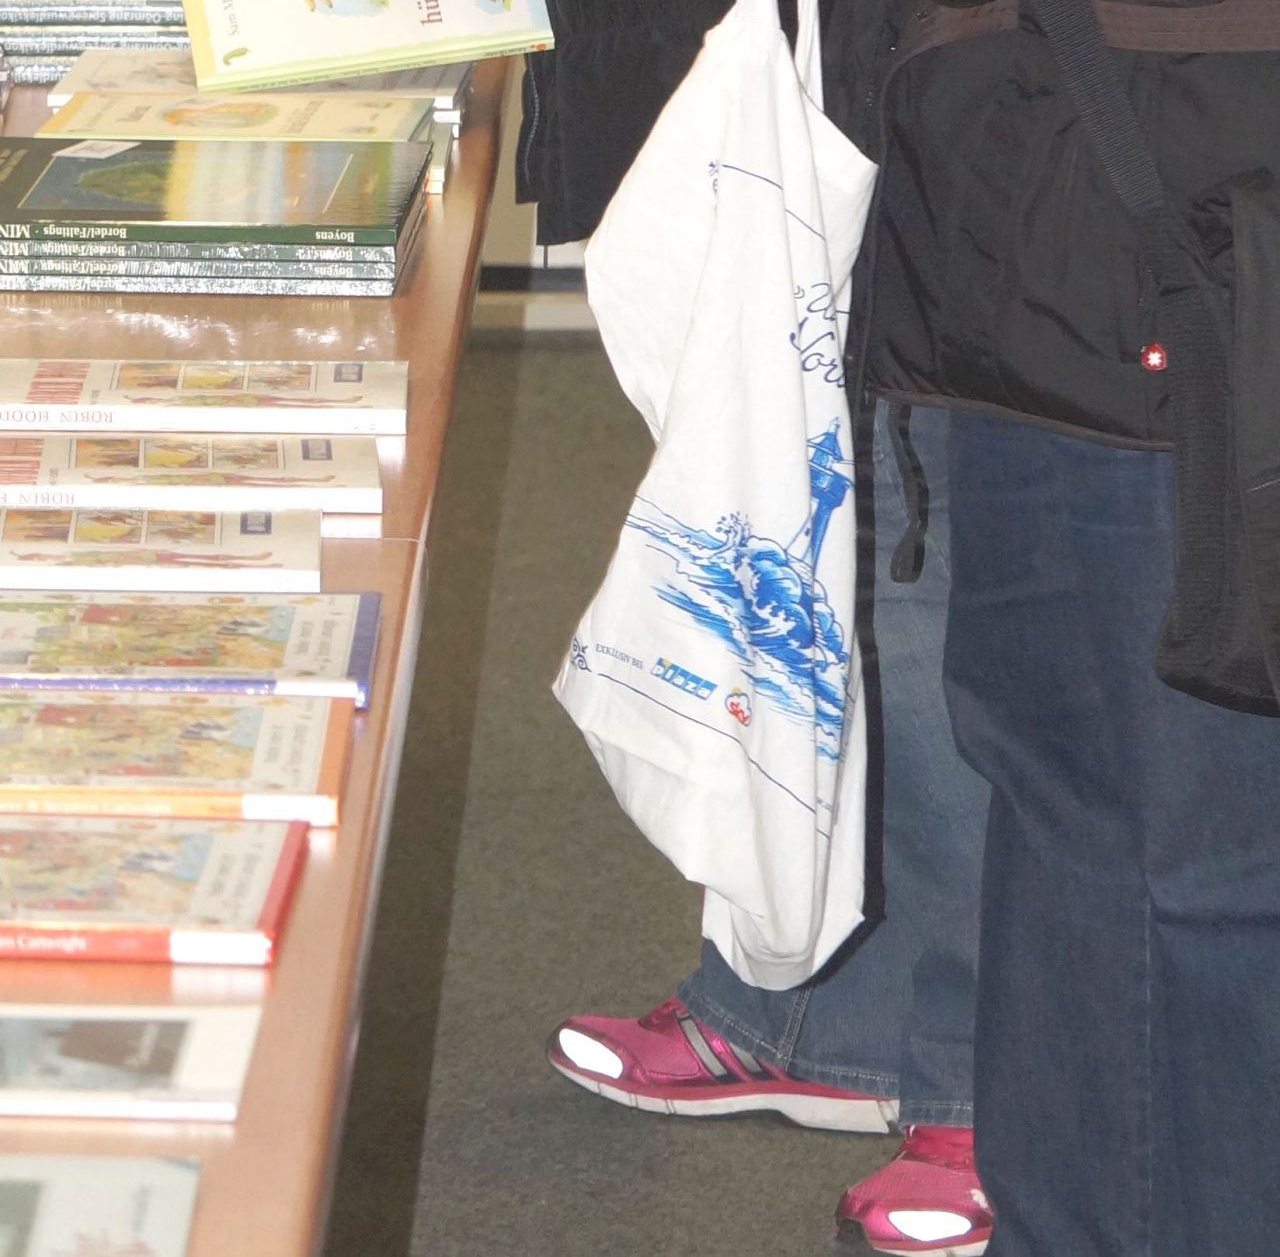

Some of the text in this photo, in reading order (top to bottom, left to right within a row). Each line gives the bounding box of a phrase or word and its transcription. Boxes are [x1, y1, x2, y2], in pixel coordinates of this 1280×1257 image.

[43, 224, 128, 239] Bordel/Faltings
[315, 228, 355, 243] Boyens
[0, 409, 114, 424] ROBIN HOOD
[18, 493, 76, 505] ROBIN
[595, 643, 631, 664] EXKLUSIV
[650, 661, 712, 700] plaza
